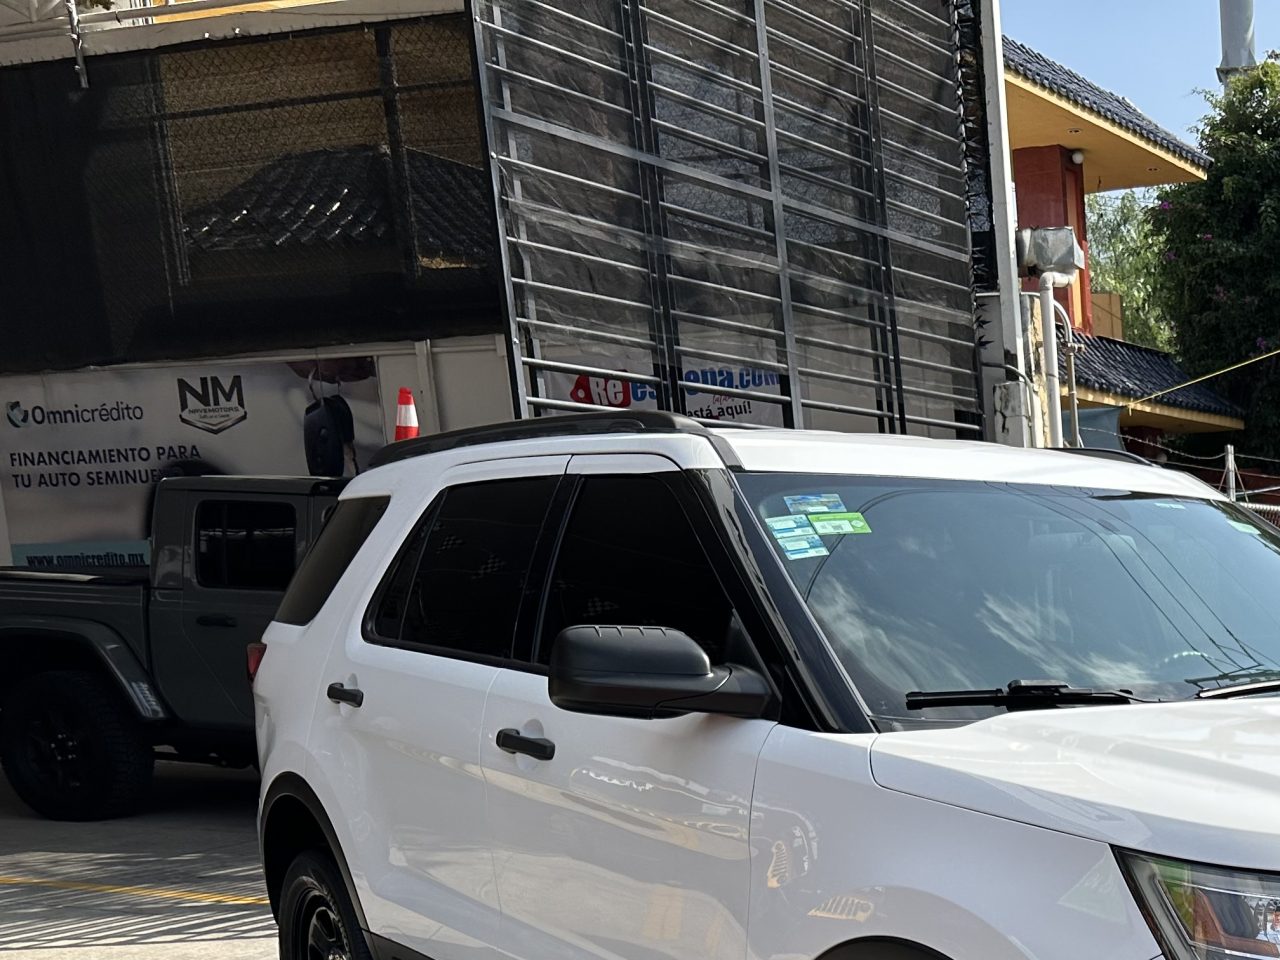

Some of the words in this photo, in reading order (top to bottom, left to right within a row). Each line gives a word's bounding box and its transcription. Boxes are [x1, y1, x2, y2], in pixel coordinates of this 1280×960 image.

[177, 375, 245, 412] NM
[31, 401, 144, 425] Omnicrédito
[718, 401, 752, 419] aquí!
[9, 447, 151, 467] FINANCIAMIENTO
[157, 445, 202, 461] PARA
[12, 473, 32, 488] TU
[38, 471, 81, 487] AUTO
